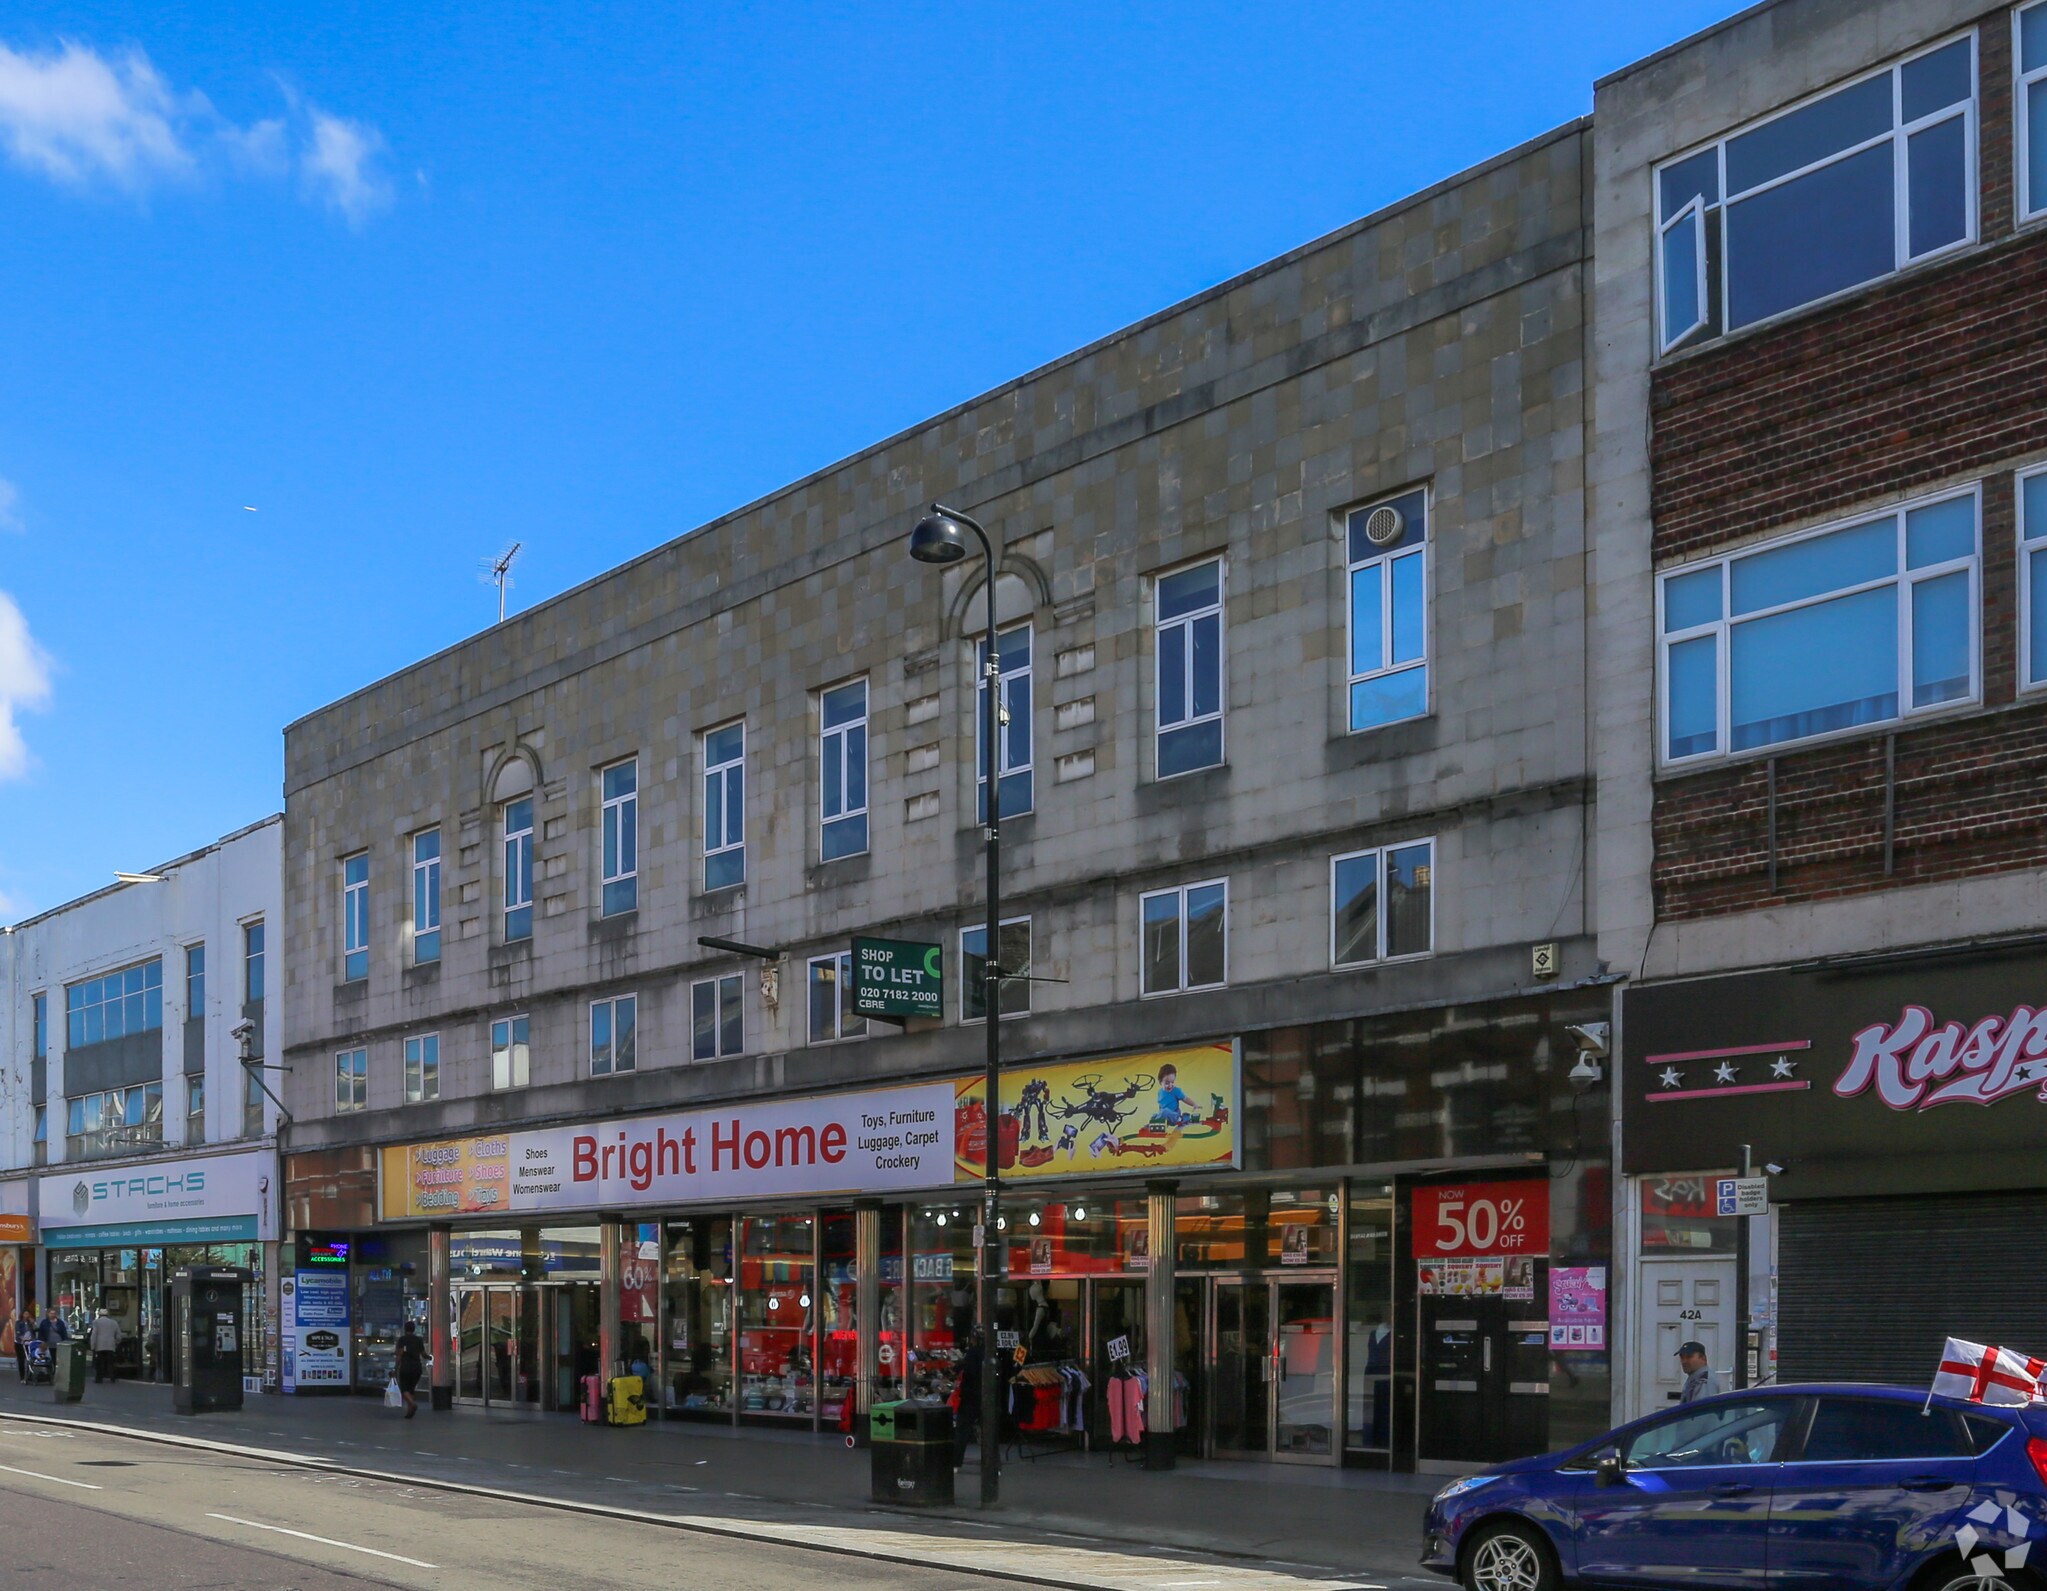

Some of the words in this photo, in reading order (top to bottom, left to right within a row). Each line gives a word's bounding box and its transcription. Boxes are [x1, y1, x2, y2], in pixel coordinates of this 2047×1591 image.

[861, 948, 893, 962] SHOP
[861, 965, 885, 981] TO
[891, 968, 924, 984] LET
[860, 987, 880, 998] 020
[882, 989, 909, 1000] 7182
[911, 991, 938, 1002] 2000
[859, 999, 885, 1009] CBRE
[861, 1113, 887, 1130] Toys,
[889, 1109, 935, 1125] Furniture
[858, 1136, 903, 1152] Luggage,
[905, 1130, 939, 1147] Carpet
[422, 1145, 460, 1164] Luggage
[475, 1140, 507, 1157] Cloths
[525, 1148, 548, 1160] Shoes
[572, 1126, 697, 1191] Bright
[711, 1119, 847, 1172] Home
[875, 1154, 920, 1170] Crockery
[422, 1167, 464, 1185] Furniture
[475, 1163, 505, 1180] Shoes
[519, 1165, 555, 1177] Menswear
[93, 1172, 204, 1200] STACKS
[513, 1182, 561, 1195] Womenswear
[422, 1189, 459, 1207] Bedding
[1439, 1190, 1464, 1199] NOW
[1435, 1199, 1525, 1251] 50%
[1500, 1234, 1526, 1248] OFF
[301, 1276, 342, 1285] Lycamobile
[1680, 1310, 1702, 1320] 42A
[1015, 1347, 1025, 1360] £2
[1108, 1339, 1128, 1360] £1.99
